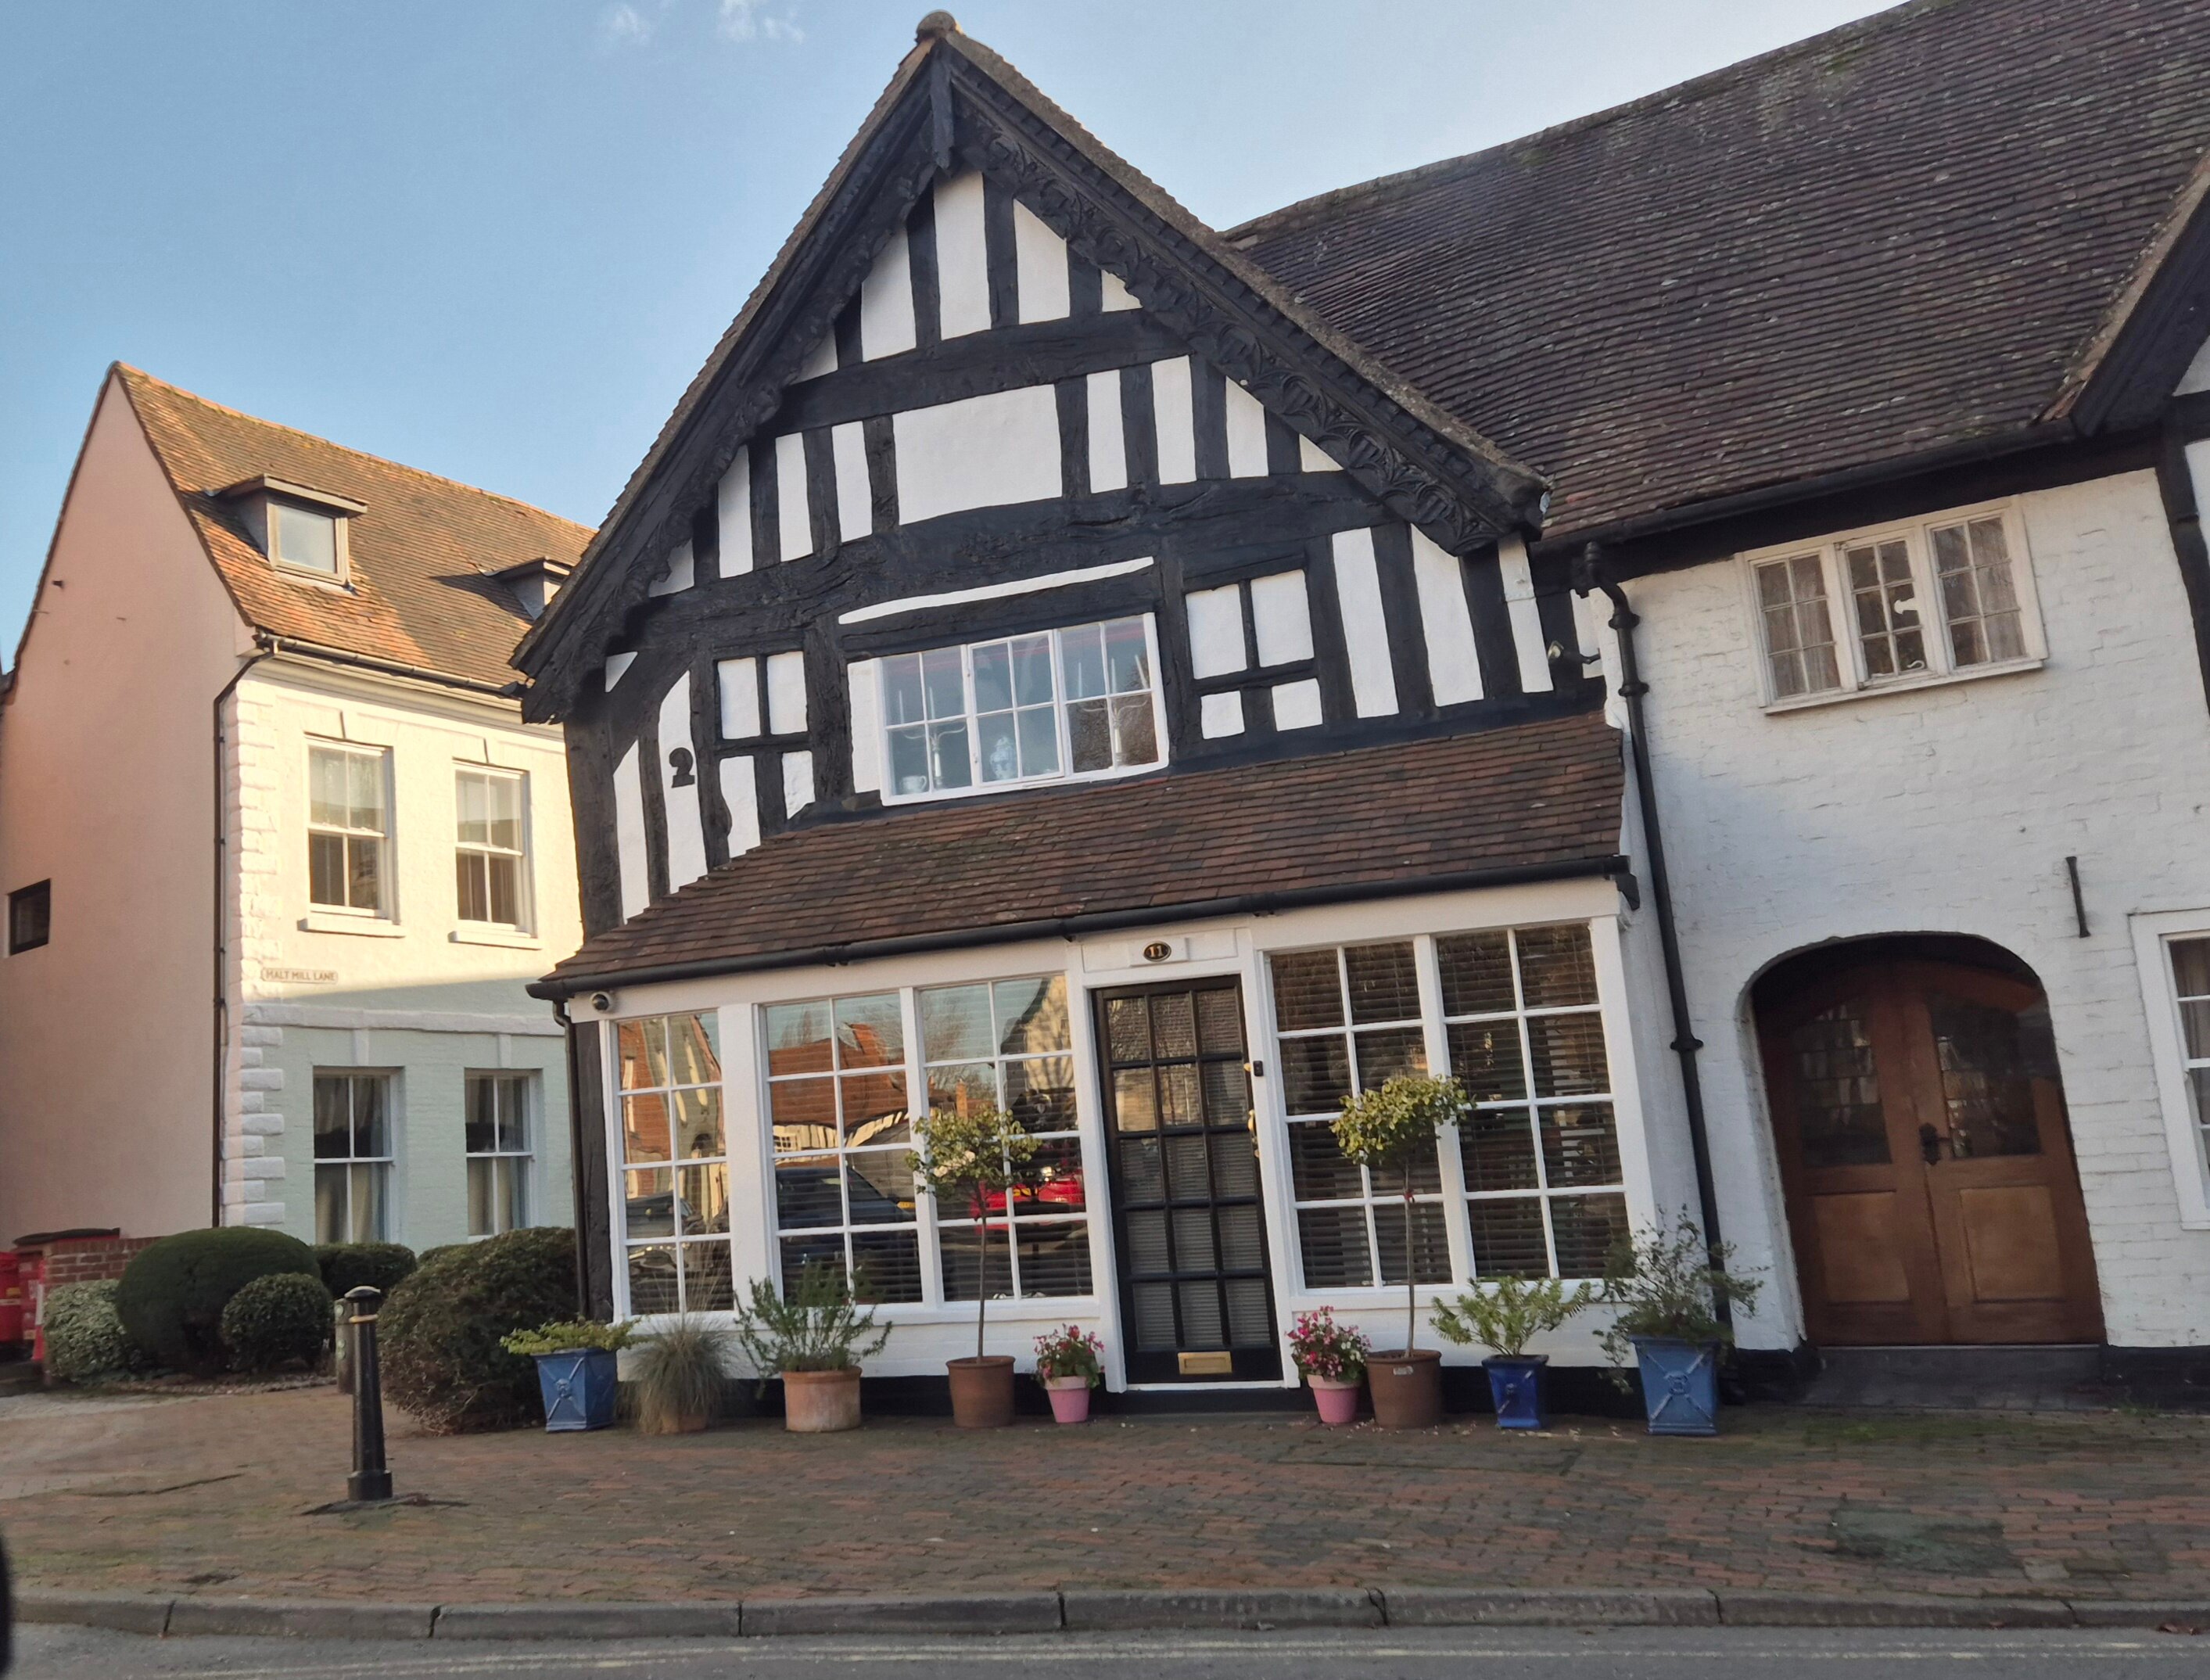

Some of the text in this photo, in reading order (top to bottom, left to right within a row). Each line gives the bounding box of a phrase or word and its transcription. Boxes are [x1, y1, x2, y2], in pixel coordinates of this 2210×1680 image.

[1150, 945, 1164, 957] 11
[266, 970, 335, 981] MALT MILL LANE
